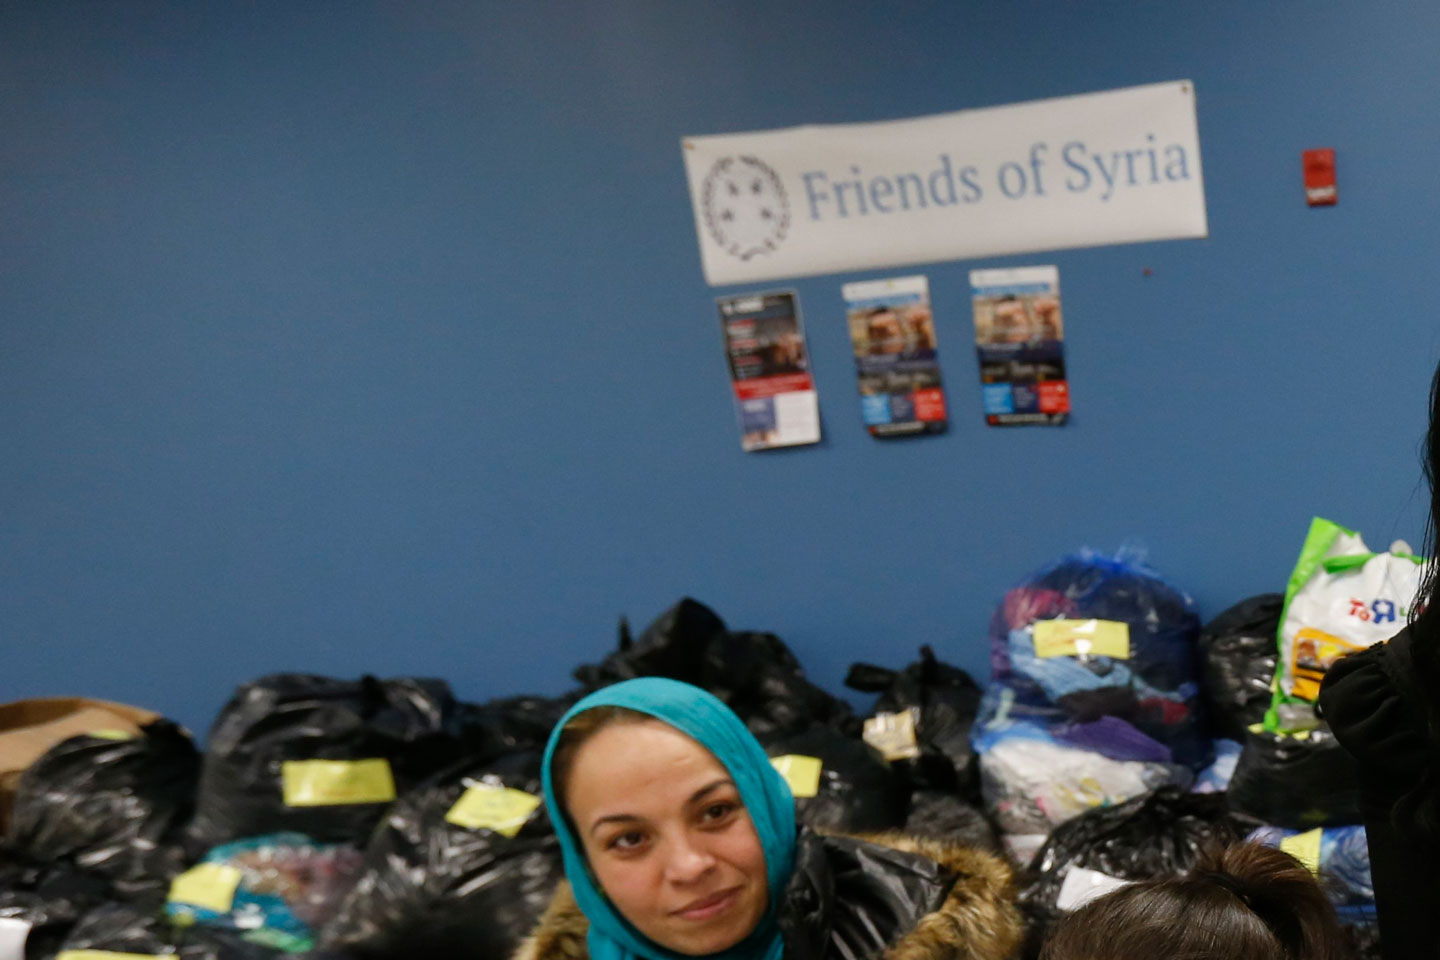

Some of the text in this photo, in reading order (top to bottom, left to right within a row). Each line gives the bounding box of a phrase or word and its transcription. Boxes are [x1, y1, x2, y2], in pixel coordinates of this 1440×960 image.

[801, 133, 1192, 222] Friends of Syria
